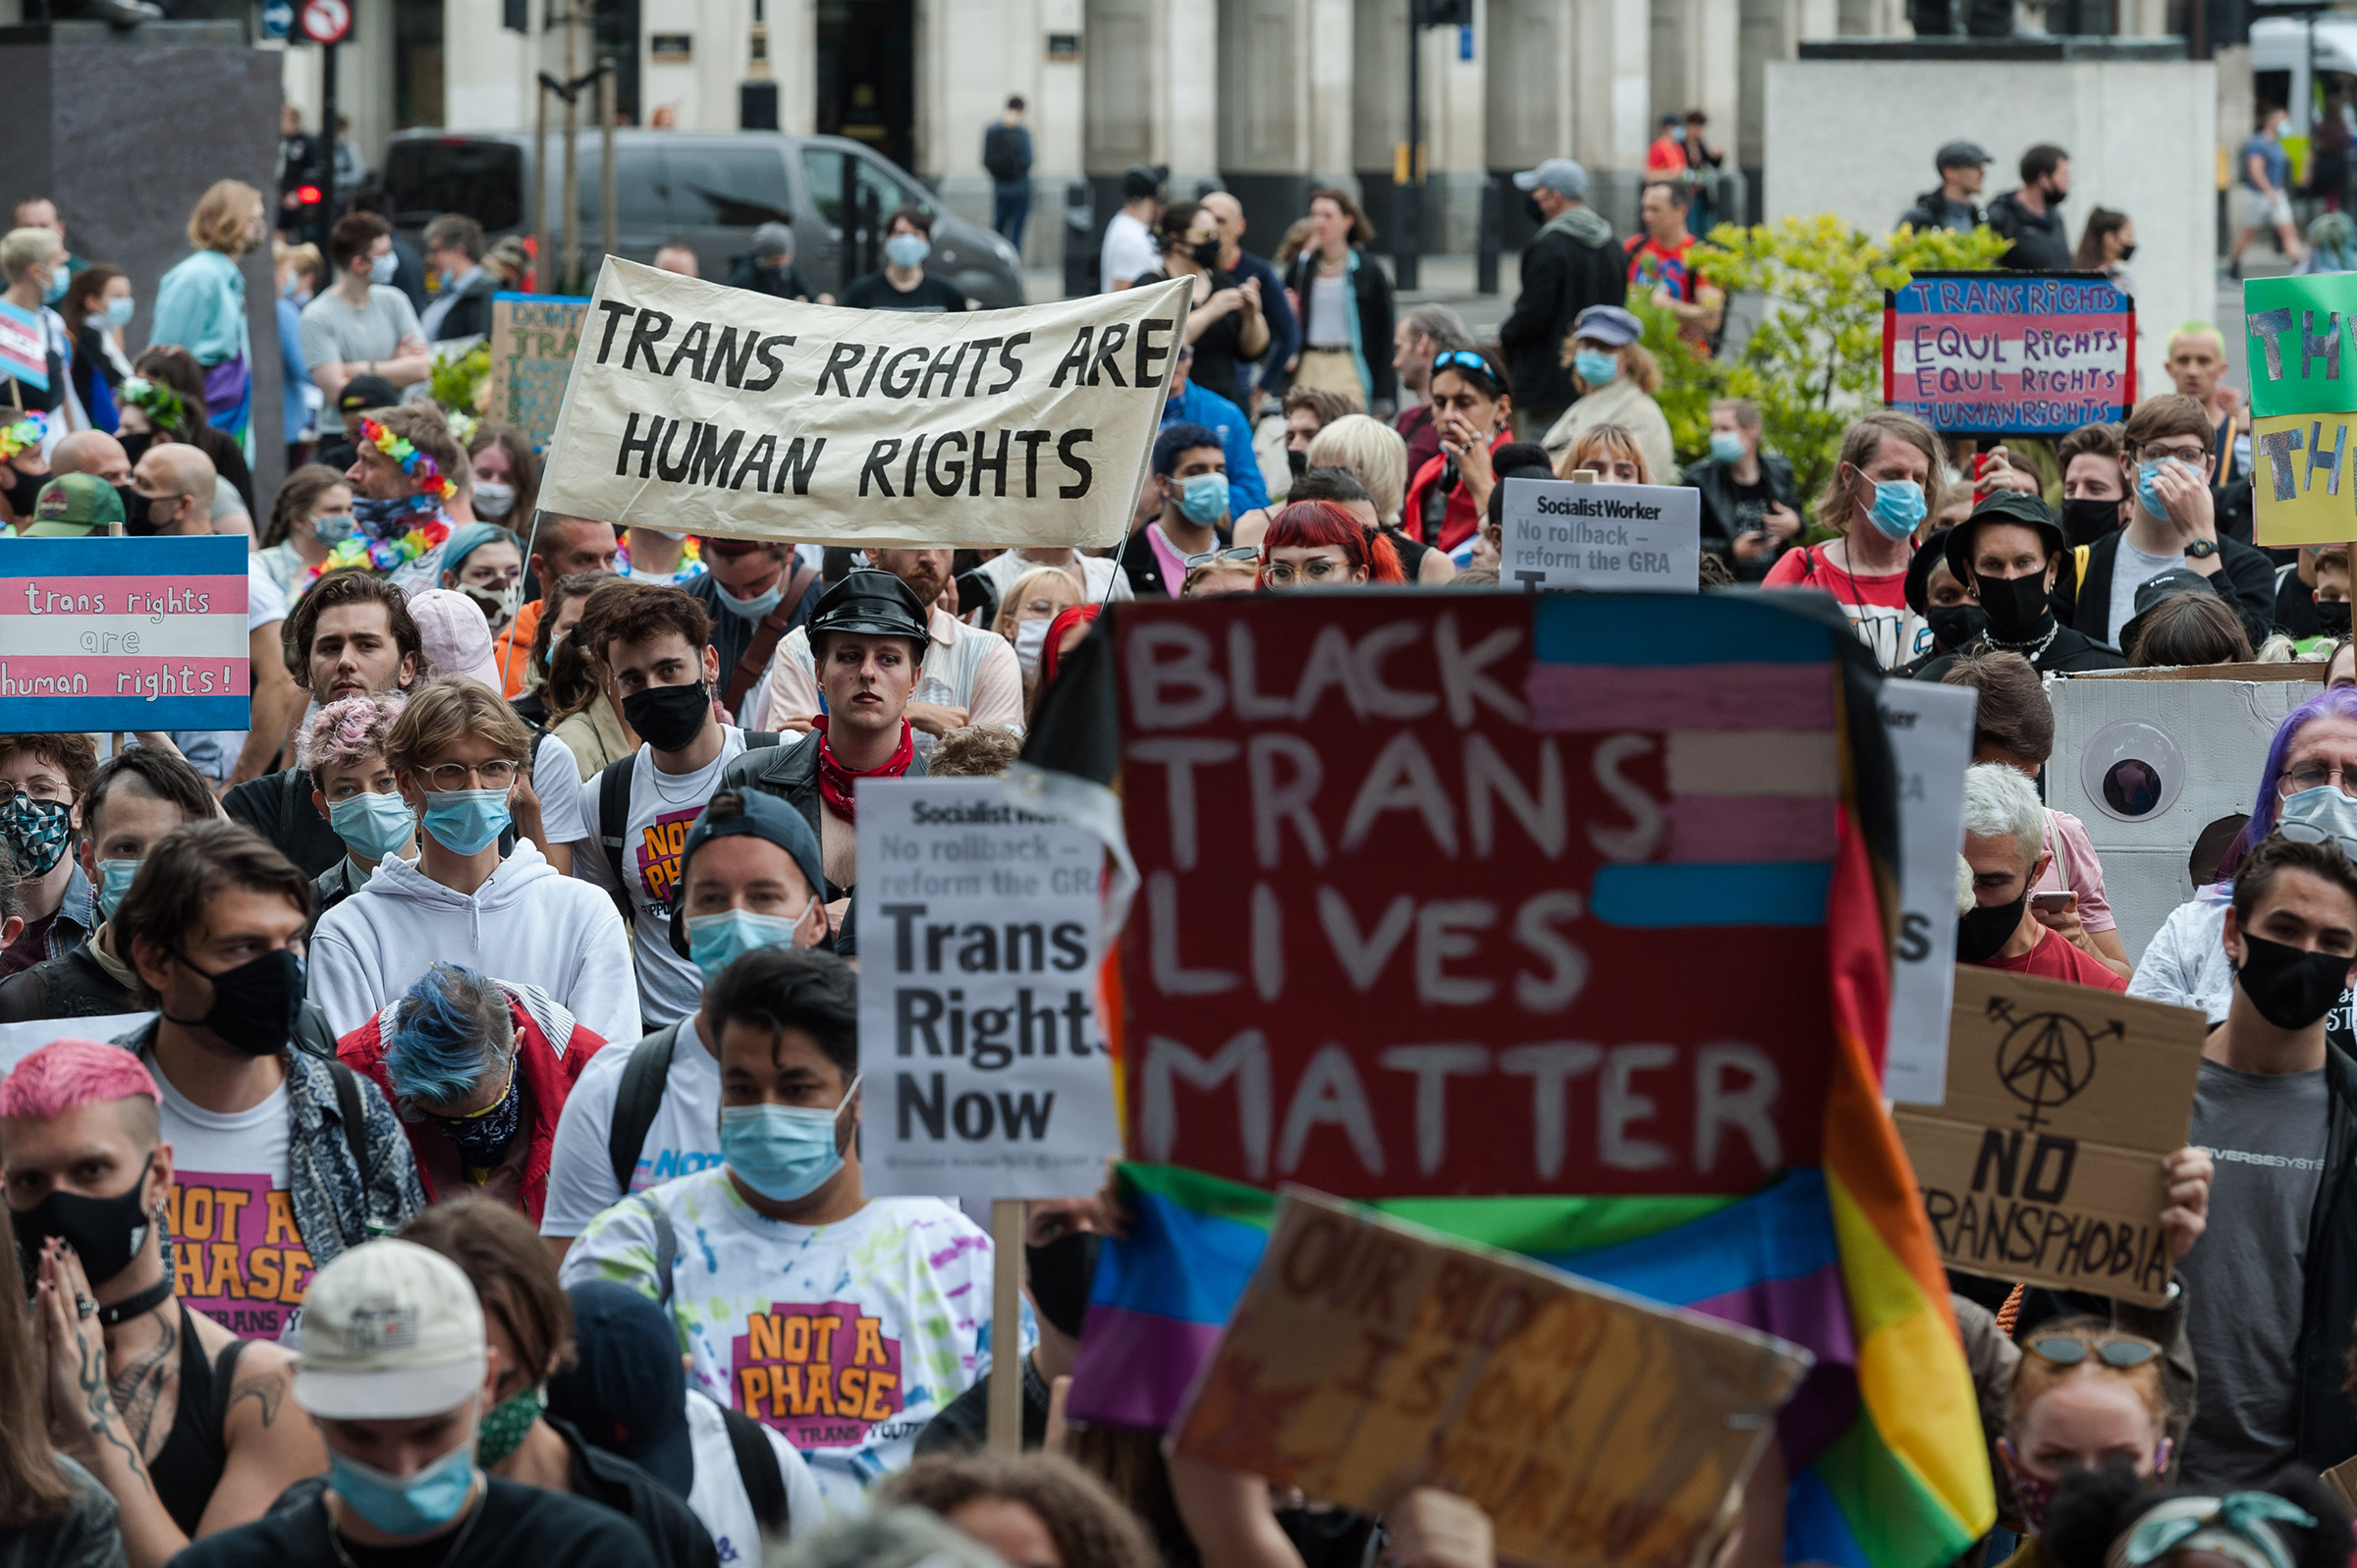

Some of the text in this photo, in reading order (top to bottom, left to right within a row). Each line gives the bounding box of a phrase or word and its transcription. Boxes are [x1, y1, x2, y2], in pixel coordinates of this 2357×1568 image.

[1911, 281, 2021, 314] TRANS
[596, 298, 1174, 399] TRANS RIGHTS ARE
[1914, 324, 2006, 363] EQUL
[2247, 307, 2357, 381] TH
[1916, 366, 2005, 398] EQUL
[1914, 401, 2014, 425] HUMAN
[615, 411, 1093, 500] HUMAN RIGHTS
[2257, 420, 2357, 515] TH
[1516, 518, 1628, 547] No rollback
[1537, 495, 1662, 520] Socialist Worker
[1515, 546, 1672, 573] reform the GRA
[24, 581, 210, 624] trans rights
[80, 630, 140, 655] are
[0, 661, 232, 702] human rights!
[1125, 611, 1530, 730] BLACK
[911, 799, 1011, 825] Socialist
[1125, 730, 1667, 870] TRANS
[880, 833, 1050, 863] No rollback
[880, 867, 1101, 895] reform the GR
[880, 902, 1087, 973] Trans
[1146, 870, 1591, 1011] LIVES
[895, 1071, 1055, 1142] Now
[1141, 1028, 1784, 1180] MATTER
[1972, 1129, 2077, 1205] NO
[1919, 1186, 2167, 1293] RANSPHOBIA
[173, 1242, 317, 1306] HASE
[747, 1313, 890, 1367] NOT A
[740, 1363, 900, 1422] PHASE
[797, 1425, 860, 1444] TRANS
